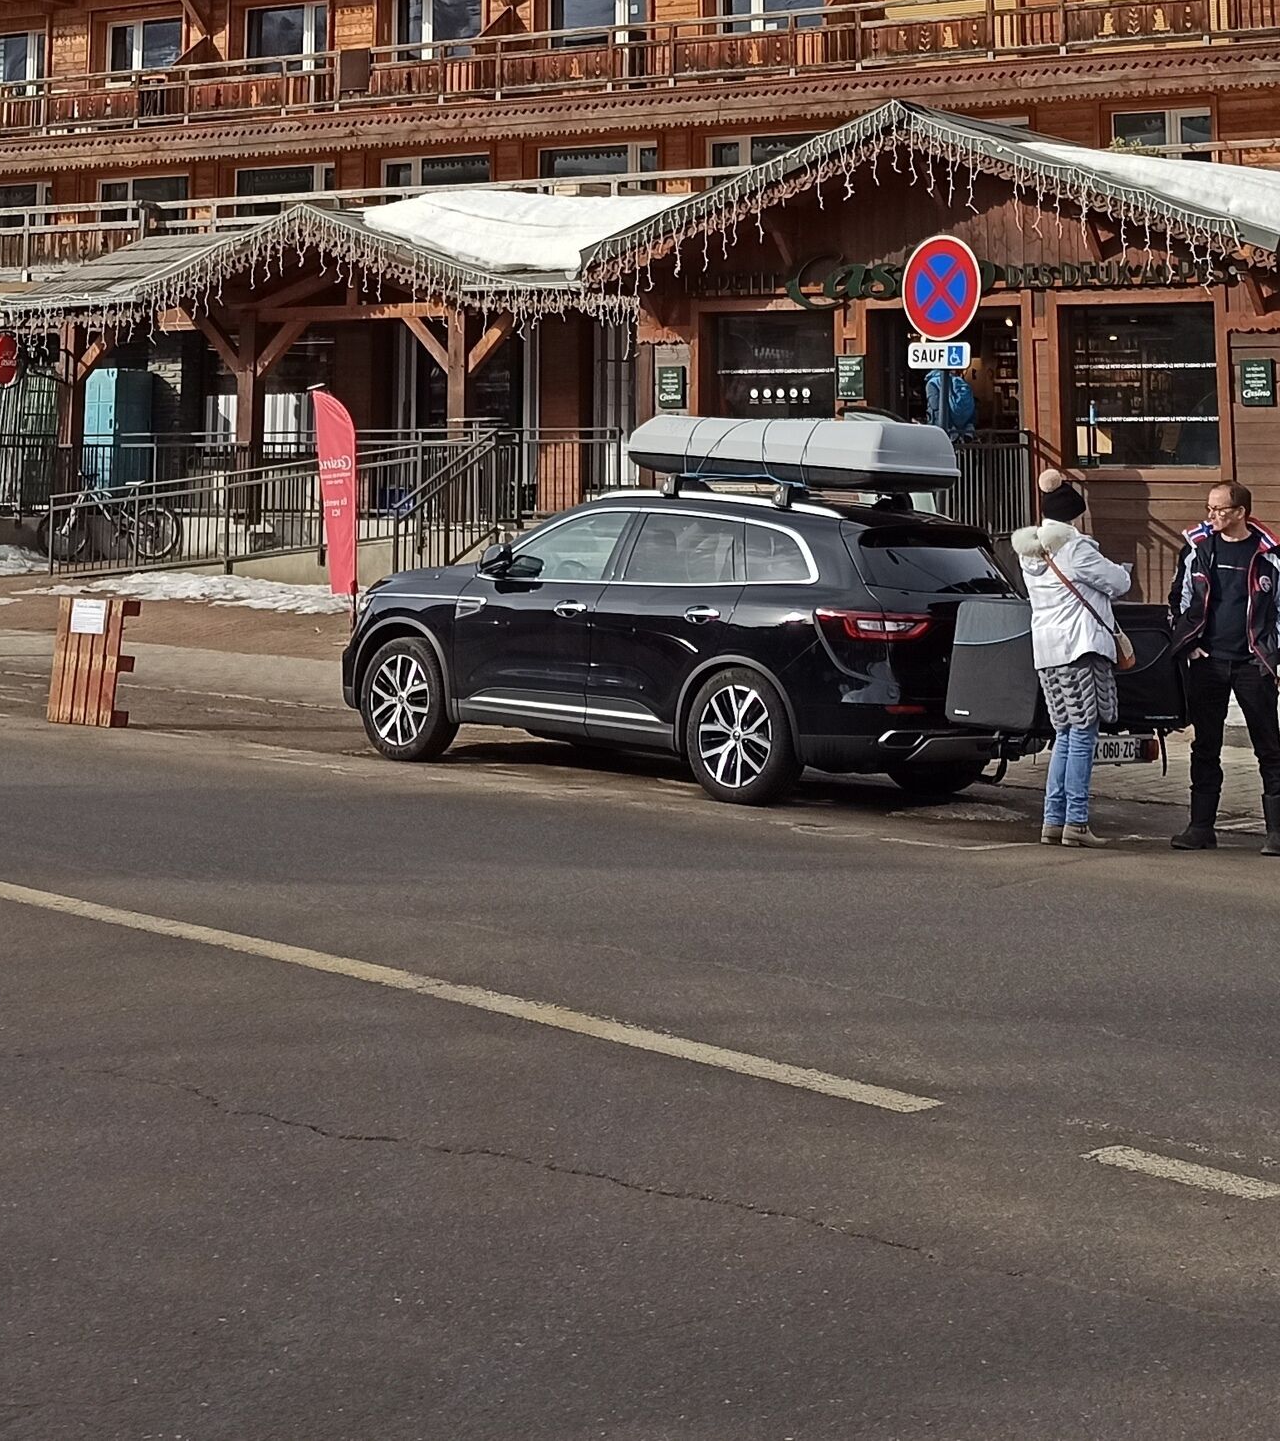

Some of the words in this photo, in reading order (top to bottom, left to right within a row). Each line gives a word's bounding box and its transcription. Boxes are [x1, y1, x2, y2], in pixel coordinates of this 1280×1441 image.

[1004, 262, 1053, 288] DES
[1061, 259, 1133, 286] DEUX
[1140, 258, 1230, 286] ALPES
[912, 349, 945, 363] SAUF
[660, 393, 681, 401] Casino
[1242, 389, 1271, 398] Casino
